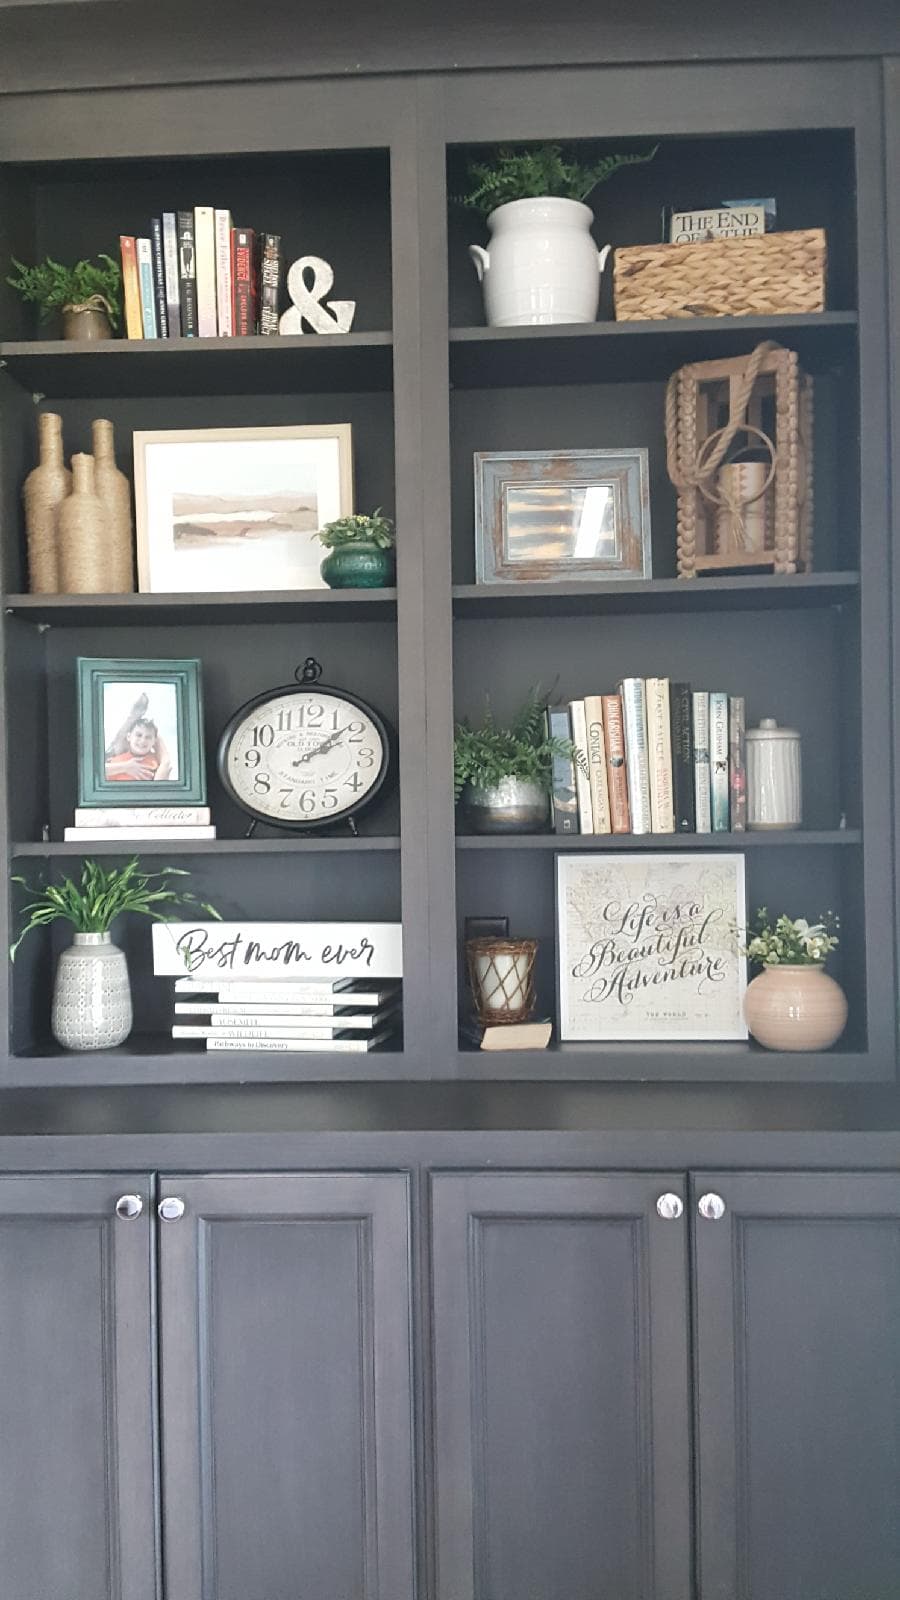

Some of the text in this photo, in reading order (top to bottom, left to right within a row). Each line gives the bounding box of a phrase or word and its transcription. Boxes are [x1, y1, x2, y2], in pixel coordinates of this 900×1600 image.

[675, 211, 760, 232] THE END
[236, 247, 247, 281] EVIDENCE
[279, 256, 356, 335] &
[277, 709, 292, 731] 11
[298, 704, 325, 728] 12
[330, 708, 339, 731] 1
[607, 700, 623, 752] JOHN GRISHAM
[714, 699, 726, 756] JOHN GRISHAM
[252, 724, 275, 748] 10
[347, 721, 367, 743] 2
[588, 721, 603, 766] CONTACT
[244, 749, 261, 769] 9
[356, 747, 375, 768] 3
[253, 772, 271, 795] 8
[342, 771, 364, 793] 4
[279, 788, 294, 808] 7
[299, 789, 316, 813] 6
[321, 788, 339, 809] 5
[602, 893, 705, 943] Life is a
[176, 928, 375, 973] Best mom ever
[571, 908, 724, 978] Beautiful
[582, 950, 729, 1006] Adventure
